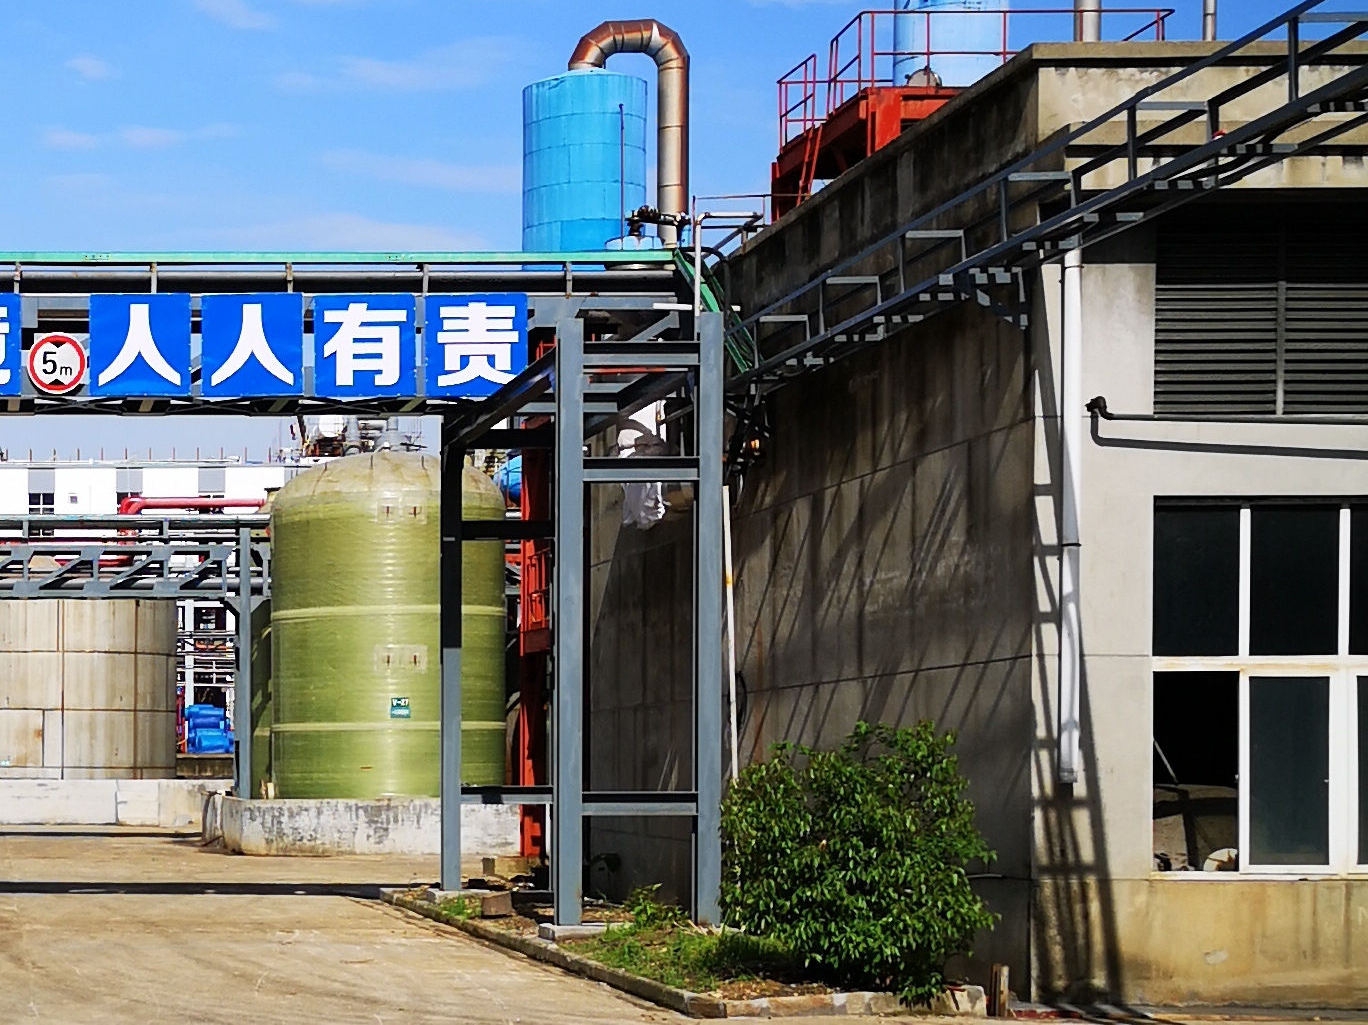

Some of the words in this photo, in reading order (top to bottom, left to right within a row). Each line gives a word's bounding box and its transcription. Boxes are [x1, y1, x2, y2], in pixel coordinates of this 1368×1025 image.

[42, 351, 73, 376] 5m
[97, 301, 520, 387] 人人有责
